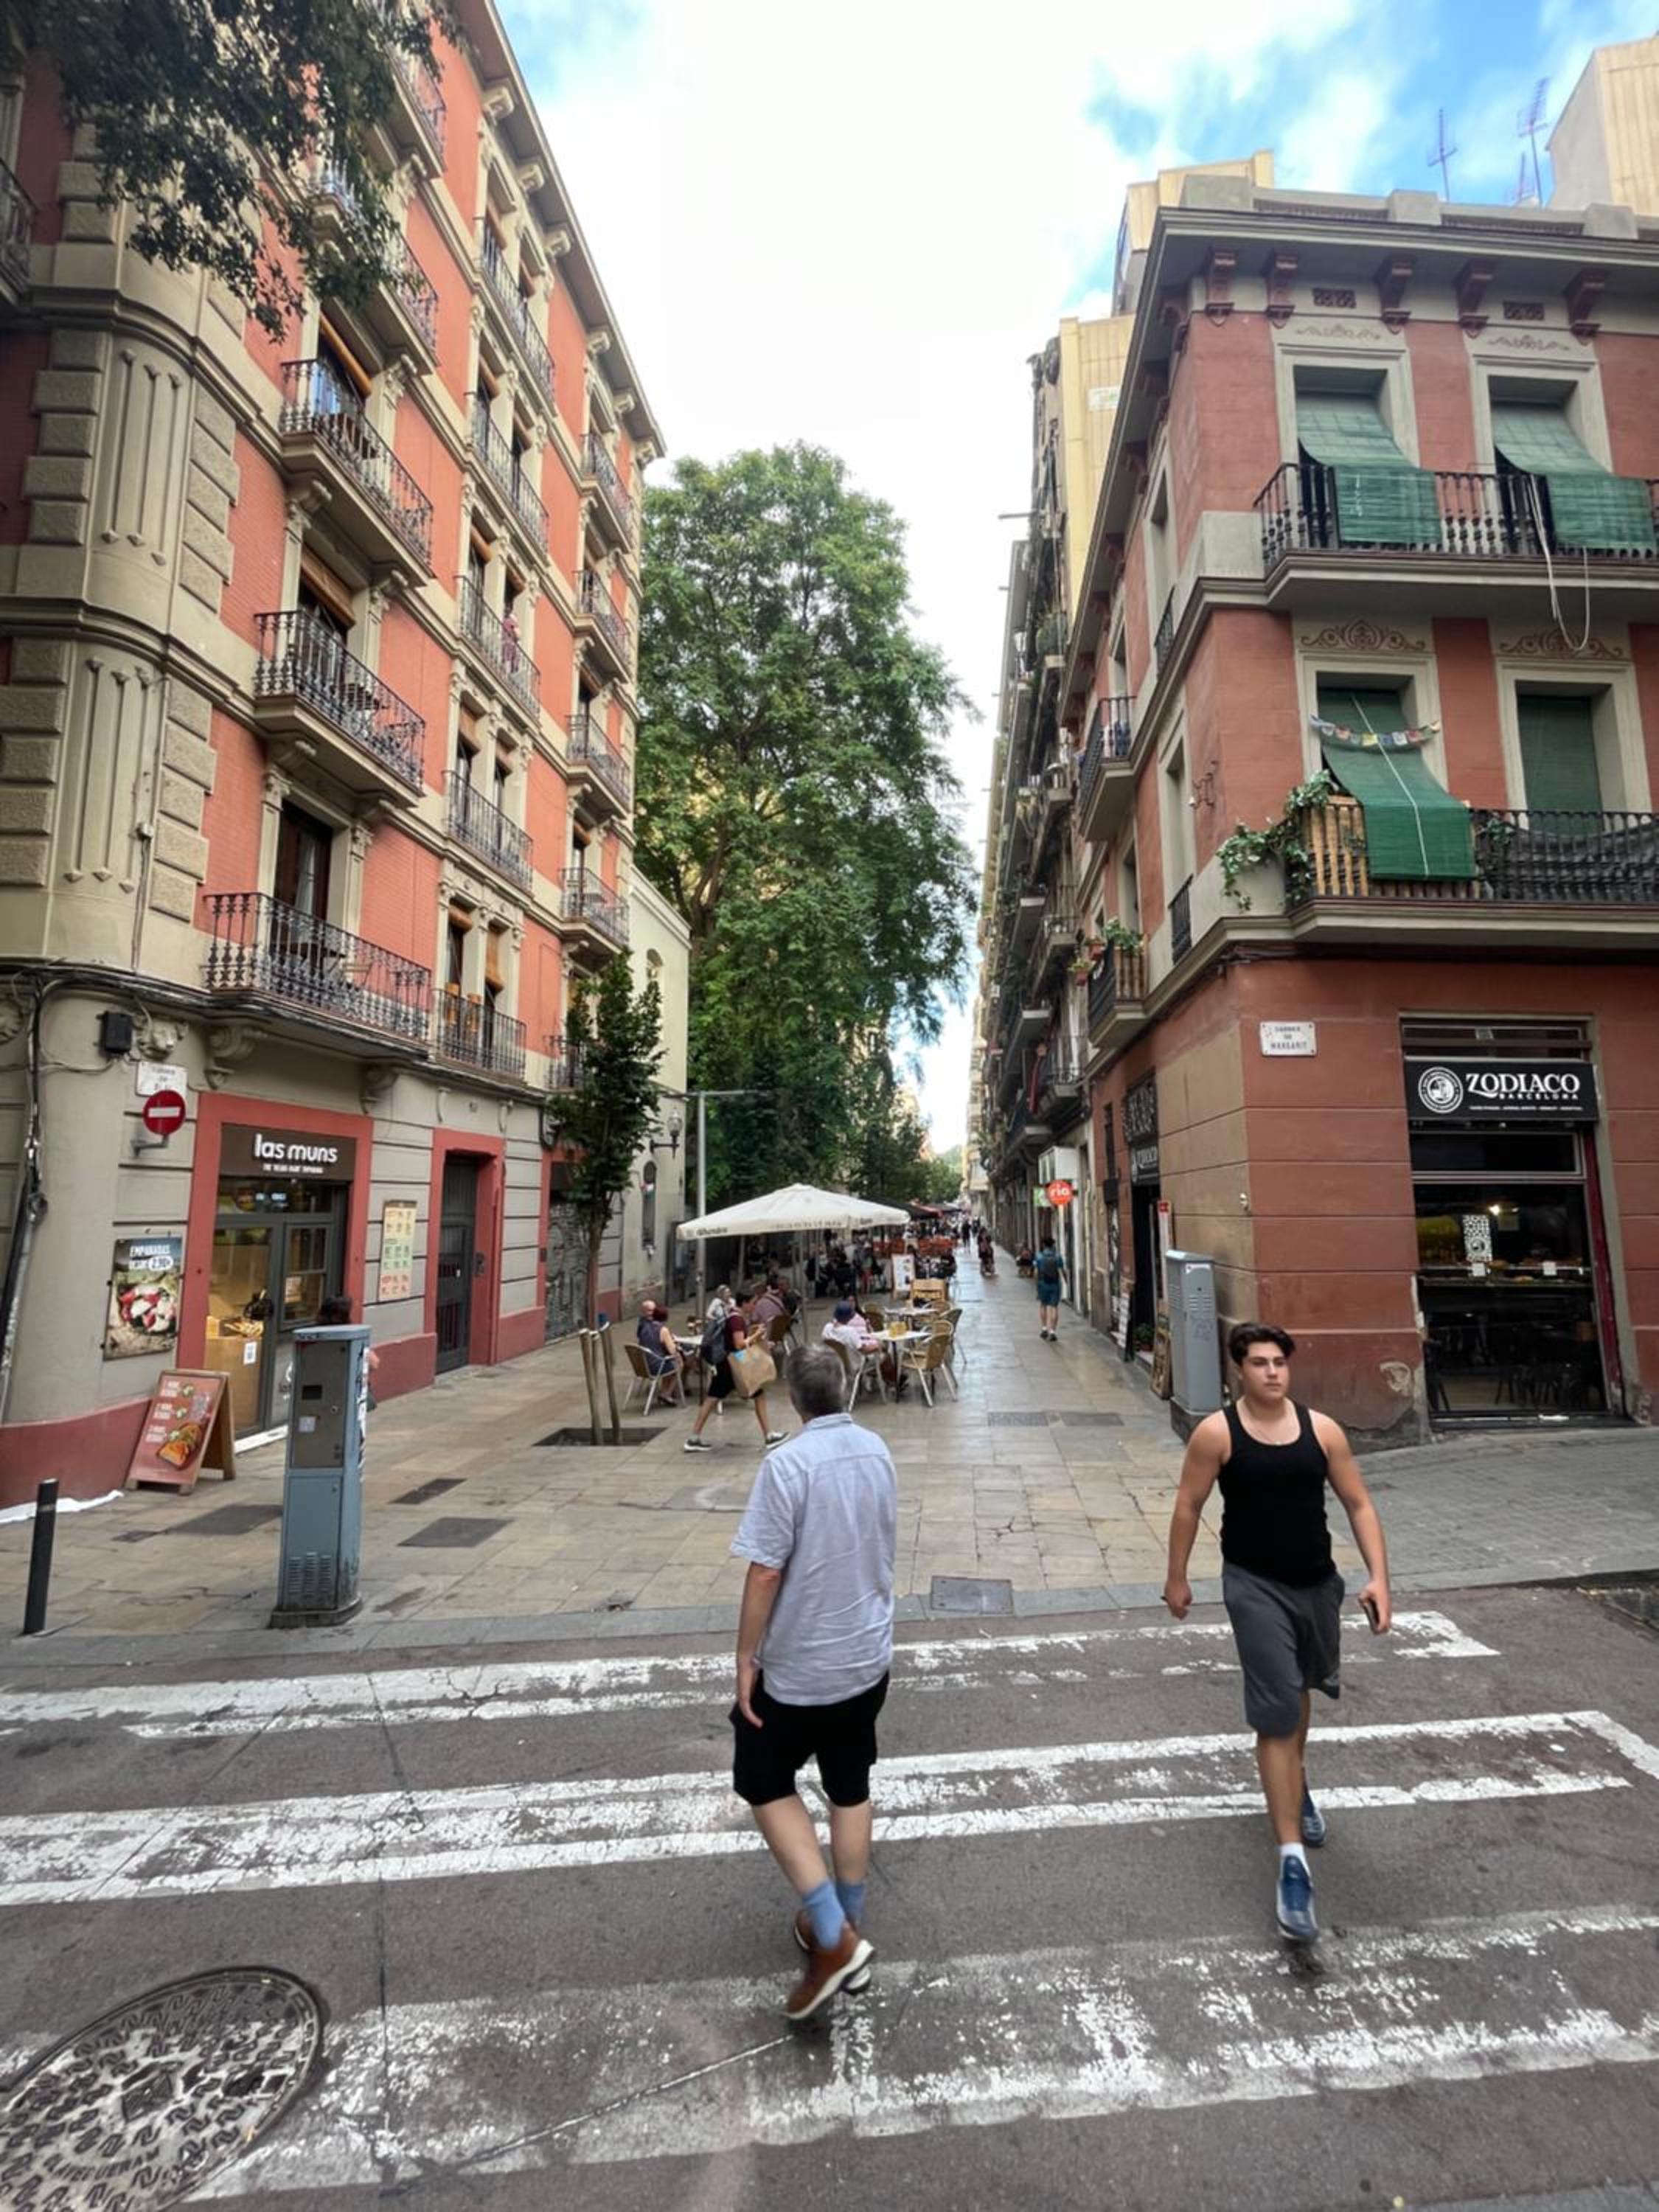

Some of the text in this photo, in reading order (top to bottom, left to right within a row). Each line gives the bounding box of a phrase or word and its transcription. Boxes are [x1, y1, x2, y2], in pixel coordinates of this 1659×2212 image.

[1465, 1073, 1581, 1099] ZODIACO
[1498, 1093, 1579, 1101] BARCELONA
[254, 1133, 338, 1163] las muns
